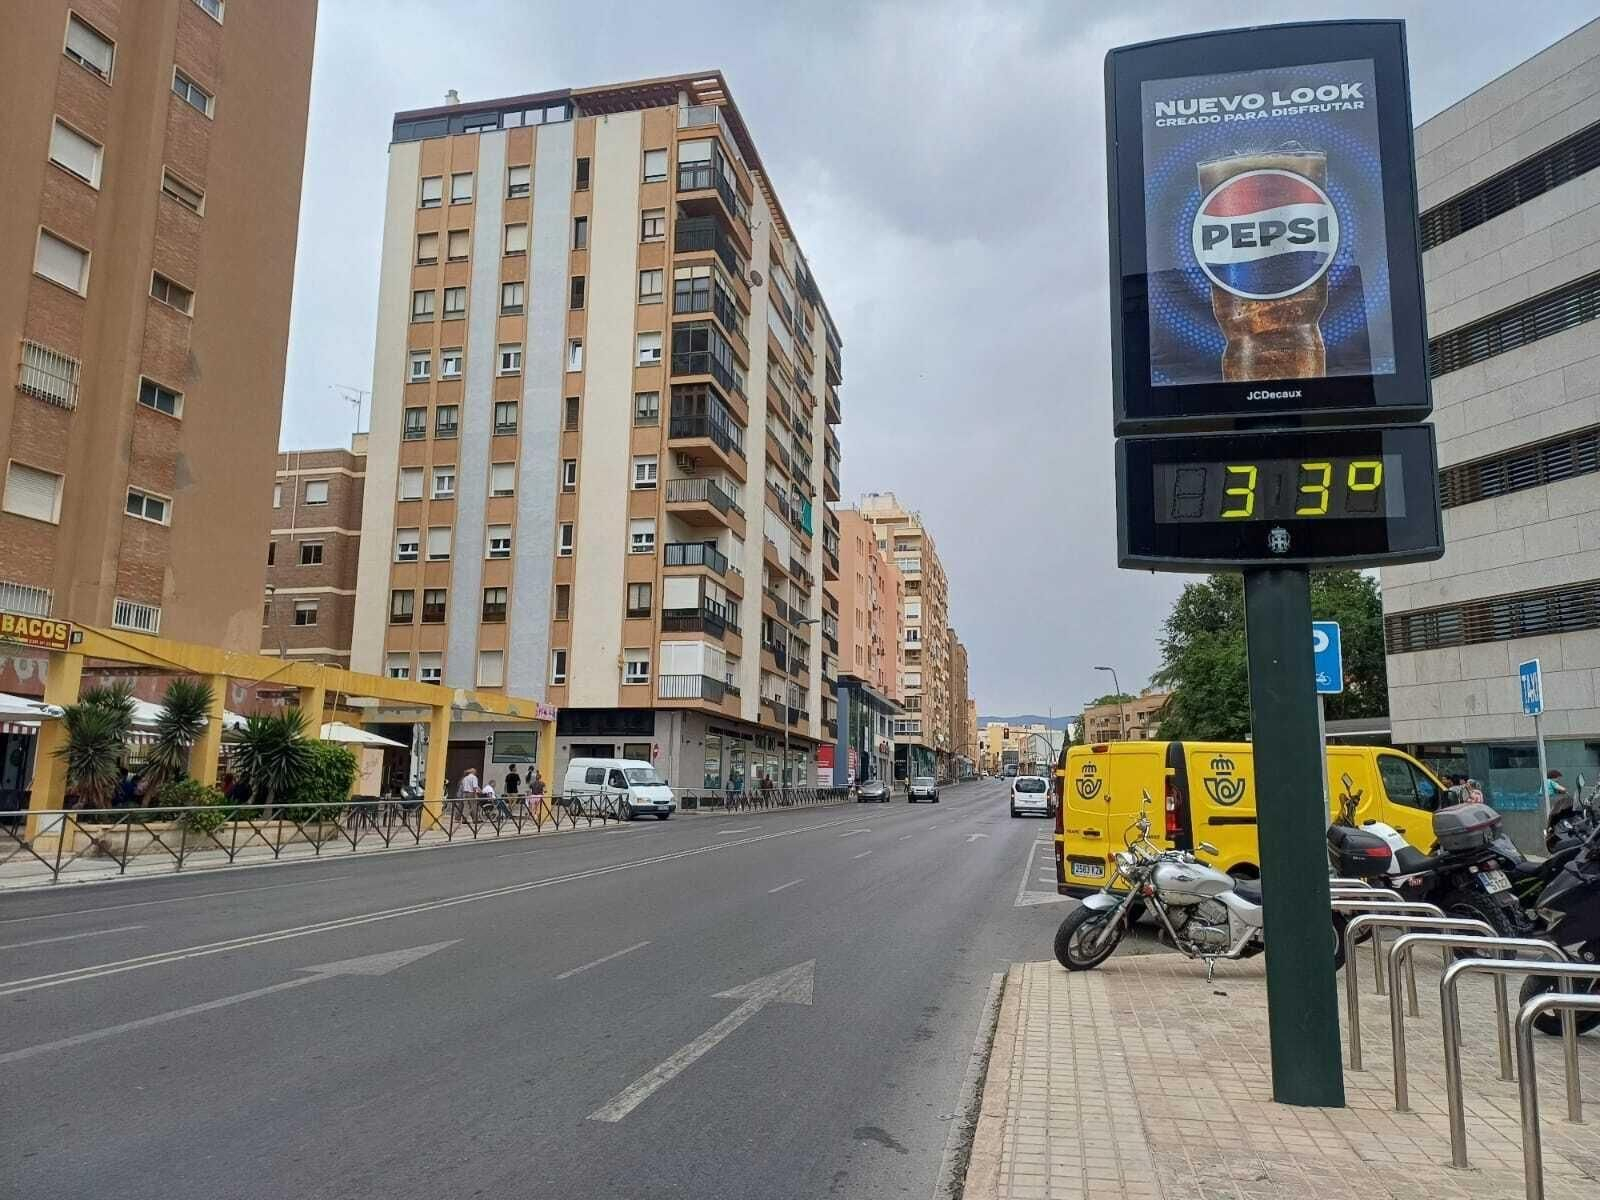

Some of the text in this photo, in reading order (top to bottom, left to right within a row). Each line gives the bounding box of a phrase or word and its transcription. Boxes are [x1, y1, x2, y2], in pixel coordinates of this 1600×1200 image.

[1154, 82, 1364, 117] NUEVO LOOK
[1155, 100, 1365, 128] CREADO PARA DISFRUTAR
[1201, 216, 1330, 251] PEPSI
[1246, 388, 1303, 401] JCDecaux
